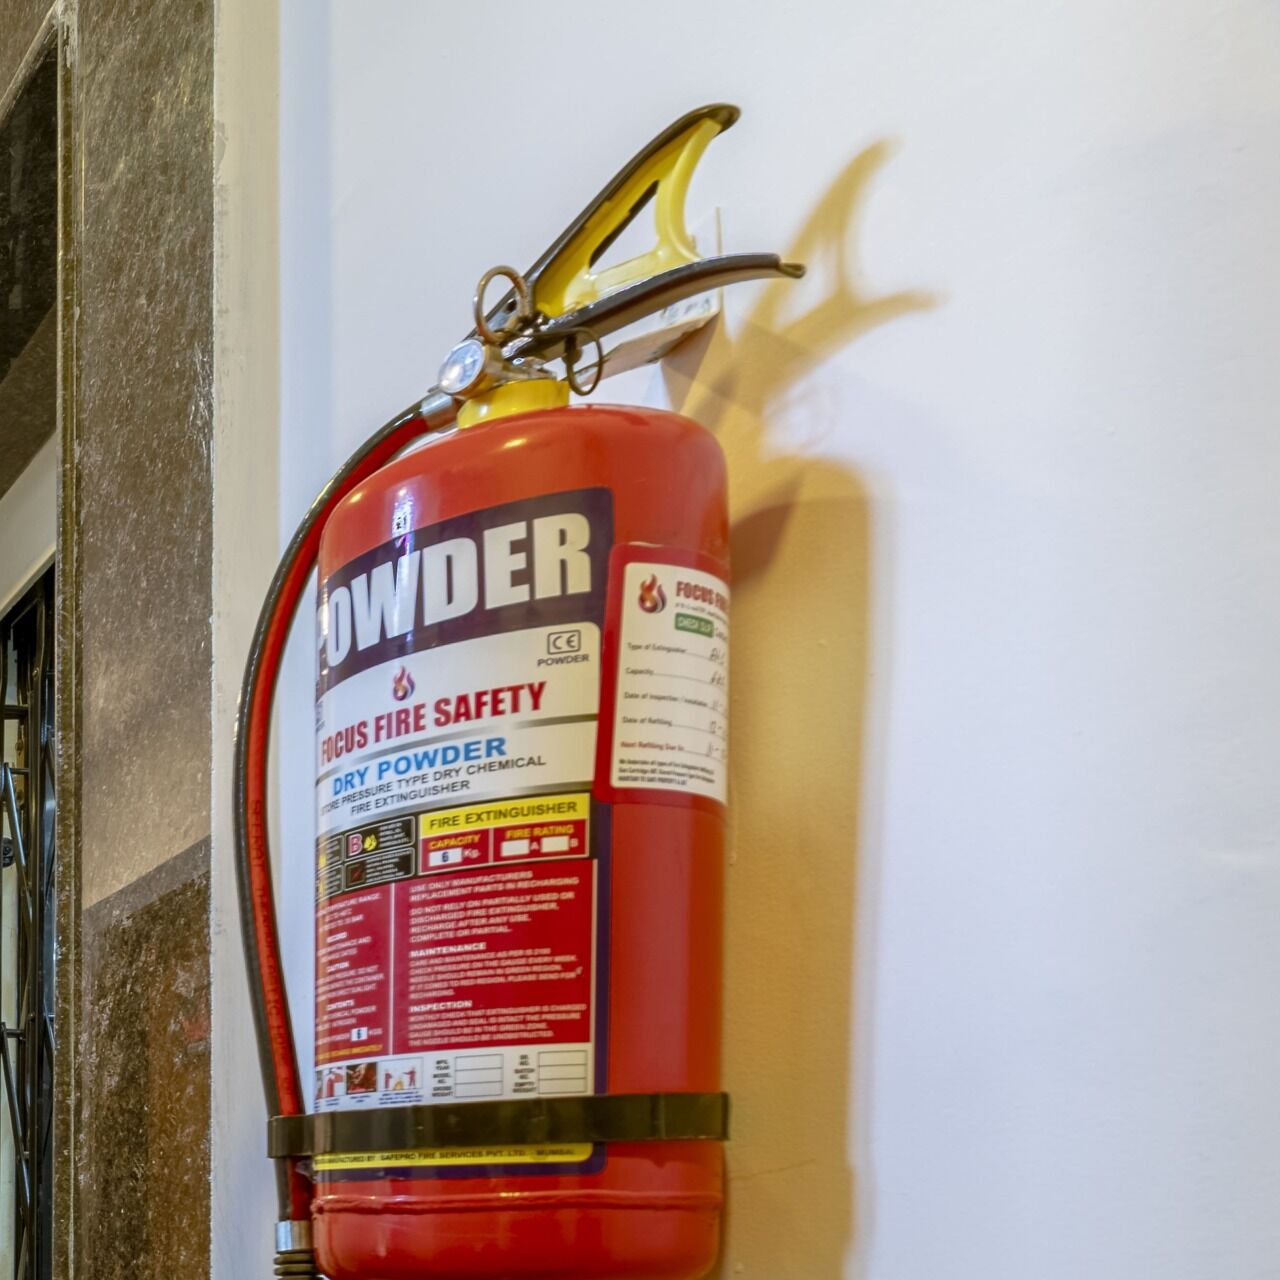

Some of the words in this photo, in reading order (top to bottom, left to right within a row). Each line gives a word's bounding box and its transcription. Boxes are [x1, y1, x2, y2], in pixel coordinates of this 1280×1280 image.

[537, 654, 590, 667] POWDER
[321, 720, 368, 767] FOCUS
[374, 703, 426, 743] FIRE
[434, 681, 547, 727] SAFETY
[333, 767, 371, 797] DRY
[378, 737, 507, 781] POWDER
[341, 782, 393, 808] PRESSURE
[396, 773, 428, 791] TYPE
[433, 767, 462, 782] DRY
[467, 755, 547, 775] CHEMICAL
[351, 799, 373, 816] FIRE
[375, 780, 471, 810] EXTINGUISHER
[429, 815, 460, 830] FIRE
[465, 801, 578, 824] EXTINGUISHER
[505, 828, 530, 839] FIRE
[533, 824, 575, 837] RATING
[348, 833, 363, 856] B
[428, 834, 481, 850] CAPACITY
[441, 851, 449, 863] 6
[410, 942, 487, 957] MAINTENANCE
[409, 1000, 472, 1013] INSPECTION
